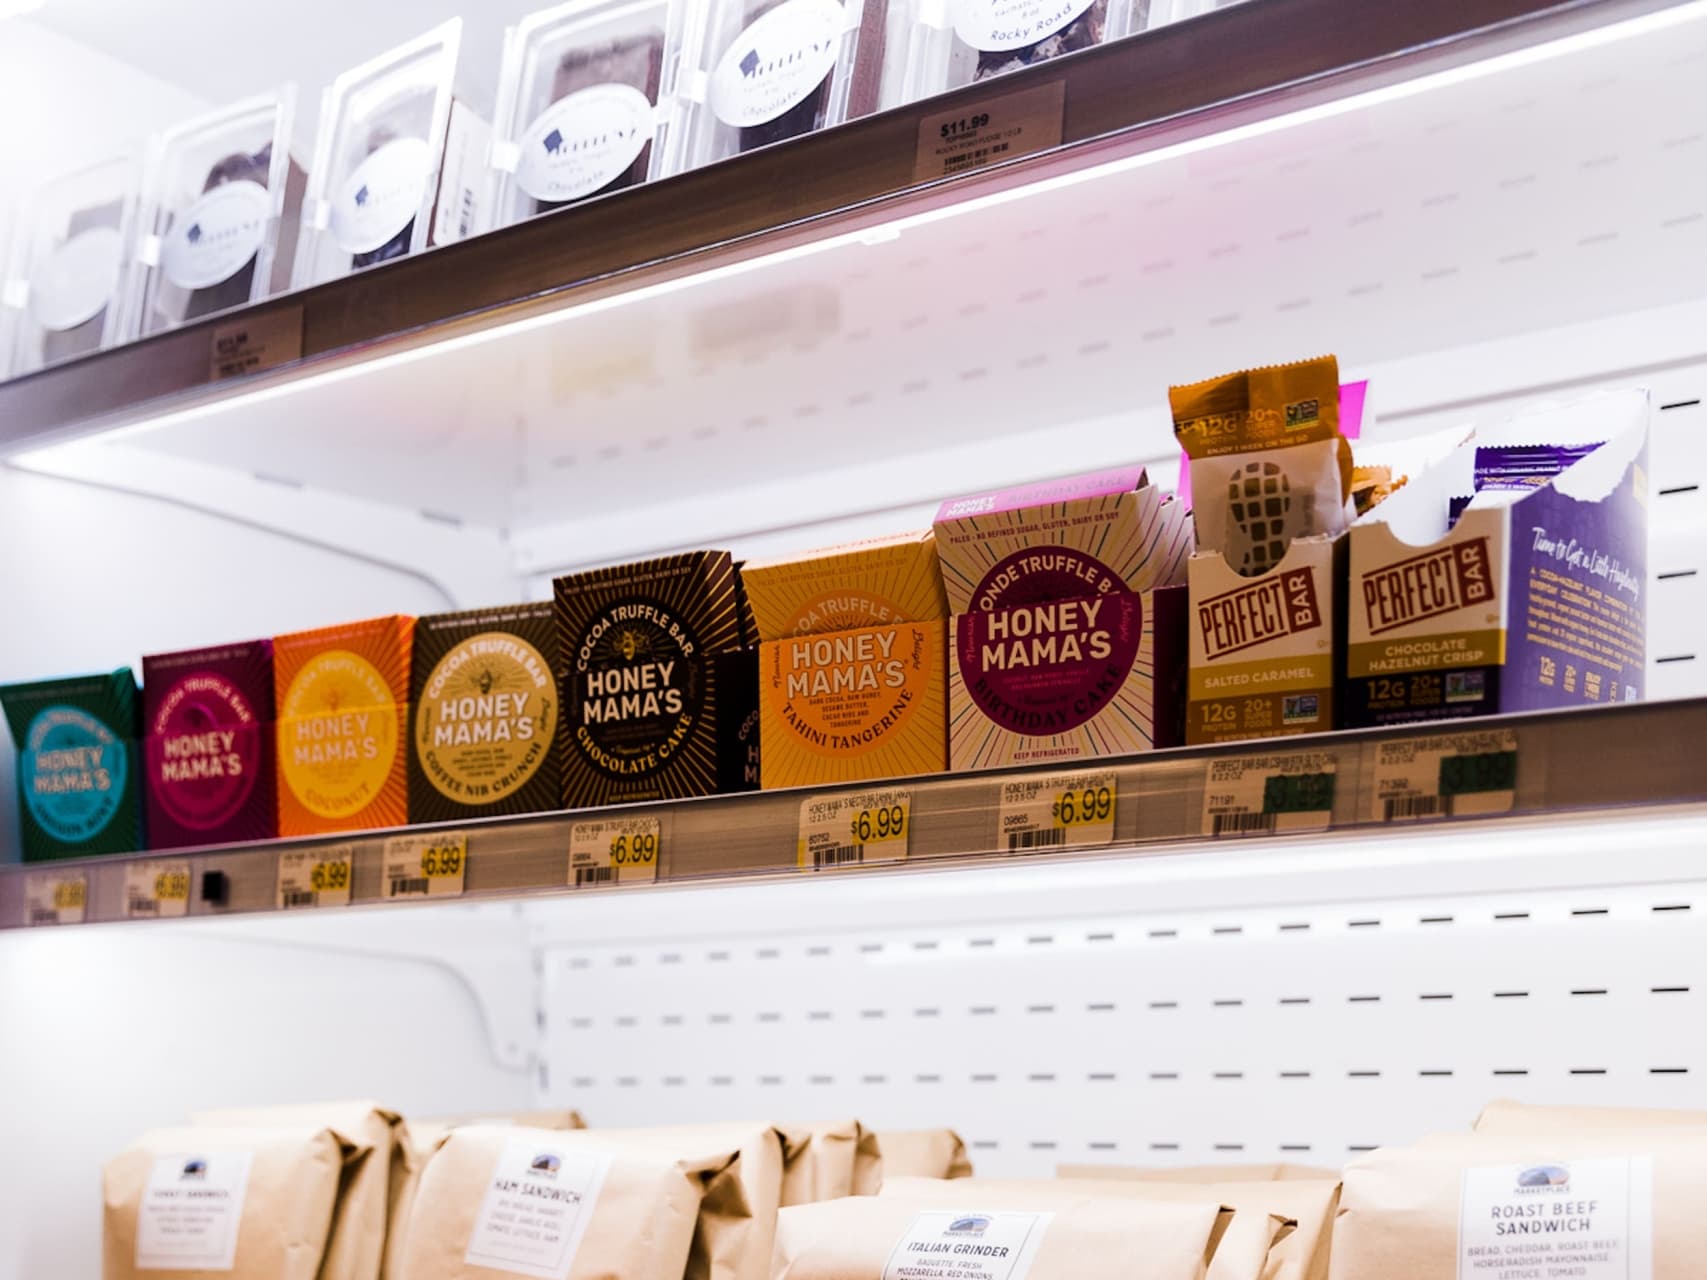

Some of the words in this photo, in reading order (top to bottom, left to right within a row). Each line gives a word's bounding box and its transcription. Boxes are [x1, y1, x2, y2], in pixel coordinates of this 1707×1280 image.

[990, 27, 1030, 41] Rocky
[1036, 5, 1072, 31] Road
[940, 113, 990, 137] $11.99
[950, 535, 970, 544] PALEO
[988, 529, 1015, 538] REFINED
[1016, 525, 1039, 534] SUGAR,
[1042, 520, 1071, 530] GLUTEN,
[1072, 517, 1092, 525] DAIRY
[1094, 514, 1104, 522] OR
[1106, 511, 1119, 520] SOY
[1019, 554, 1096, 584] TRUFFLE
[1363, 554, 1457, 629] PERFECT
[1464, 545, 1487, 601] BAR
[818, 597, 889, 620] TRUFFLE
[987, 600, 1104, 640] HONEY
[1199, 581, 1286, 656] PERFECT
[1290, 574, 1312, 626] BAR
[576, 617, 611, 672] COCOA
[610, 604, 670, 629] TRUFFLE
[668, 621, 694, 658] BAR
[792, 631, 897, 670] HONEY
[981, 630, 1112, 673] MAMA'S
[1385, 638, 1466, 657] CHOCOLATE
[429, 650, 469, 699] COCOA
[469, 639, 525, 664] TRUFFLE
[524, 657, 548, 688] BAR
[1369, 654, 1440, 671] HAZELNUT
[1442, 650, 1484, 663] CRISP
[587, 661, 675, 698] HONEY
[786, 661, 905, 699] MAMA'S
[1204, 674, 1249, 688] SALTED
[1252, 668, 1314, 683] CARAMEL
[1368, 680, 1405, 699] 12G
[184, 677, 232, 699] TRUFFLE
[230, 693, 250, 724] BAR
[440, 693, 529, 722] HONEY
[583, 688, 683, 725] MAMA'S
[974, 677, 1070, 730] BIRTHDAY
[1072, 663, 1122, 716] CAKE
[296, 714, 370, 741] HONEY
[782, 702, 827, 748] TAHINI
[831, 689, 914, 749] TANGERINE
[1201, 703, 1237, 722] 12G
[163, 730, 236, 759] HONEY
[434, 717, 534, 747] MAMA'S
[577, 726, 658, 774] CHOCOLATE
[658, 712, 692, 759] CAKE
[35, 746, 103, 770] HONEY
[294, 737, 378, 765] MAMA'S
[1013, 751, 1030, 760] KEEP
[1030, 747, 1080, 759] REFRIGERATED
[33, 768, 112, 794] MAMA'S
[161, 753, 243, 783] MAMA'S
[425, 750, 462, 794] COFFEE
[464, 784, 489, 797] NIB
[492, 741, 542, 792] CRUNCH
[1052, 787, 1111, 824] $6.99
[851, 806, 903, 840] $6.99
[421, 847, 461, 878] $6.99
[609, 834, 654, 864] $6.99
[311, 861, 347, 890] $6.99
[521, 1183, 582, 1205] SANDWICH
[1491, 1203, 1545, 1219] ROAST
[1552, 1200, 1599, 1215] BEEF
[1496, 1218, 1591, 1236] SANDWICH
[907, 1242, 951, 1253] ITALIAN
[953, 1244, 1009, 1258] GRINDER
[1558, 1241, 1589, 1251] ROAST
[958, 1261, 983, 1269] FRESH
[1473, 1256, 1543, 1268] HORSERADISH
[1547, 1267, 1587, 1278] TOMATO
